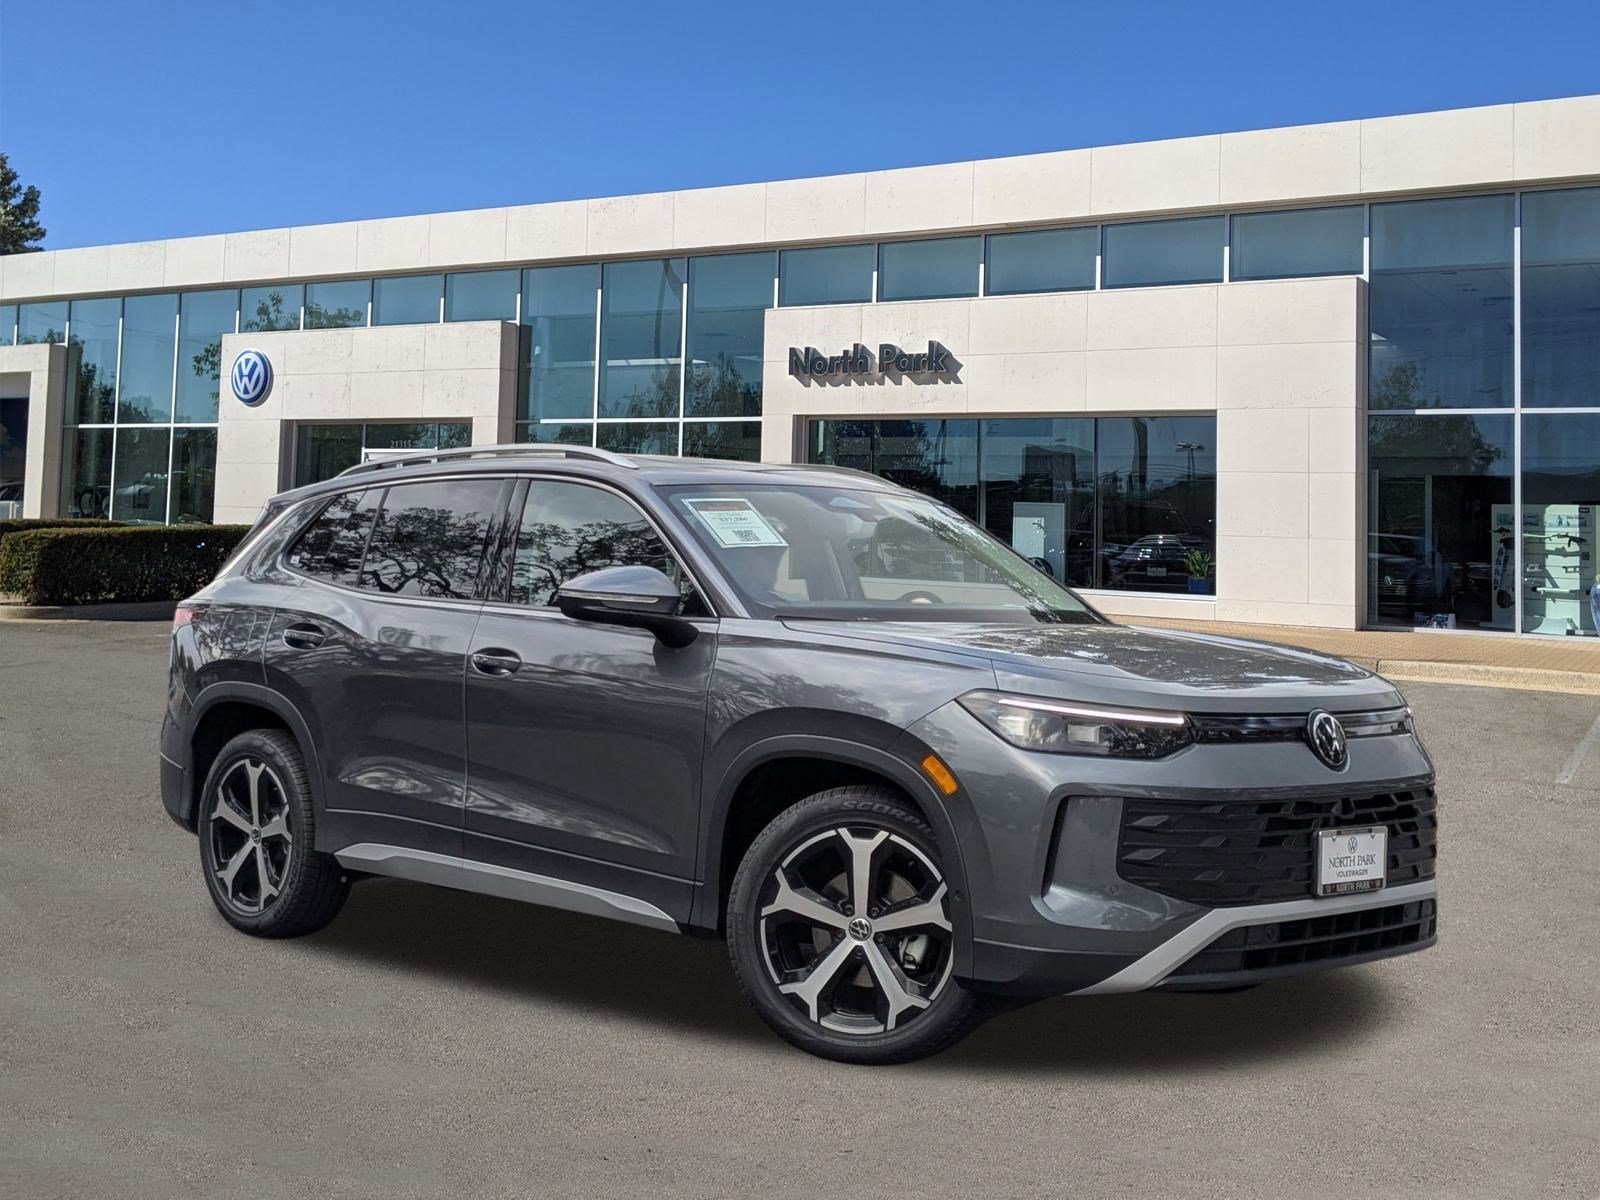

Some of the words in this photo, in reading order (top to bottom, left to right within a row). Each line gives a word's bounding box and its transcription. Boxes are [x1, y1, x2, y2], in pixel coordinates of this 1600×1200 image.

[788, 343, 872, 376] North
[878, 340, 948, 373] Park
[1329, 856, 1355, 868] NORTH
[1357, 854, 1376, 866] PARK
[1336, 869, 1368, 878] VOLKSWAGEN
